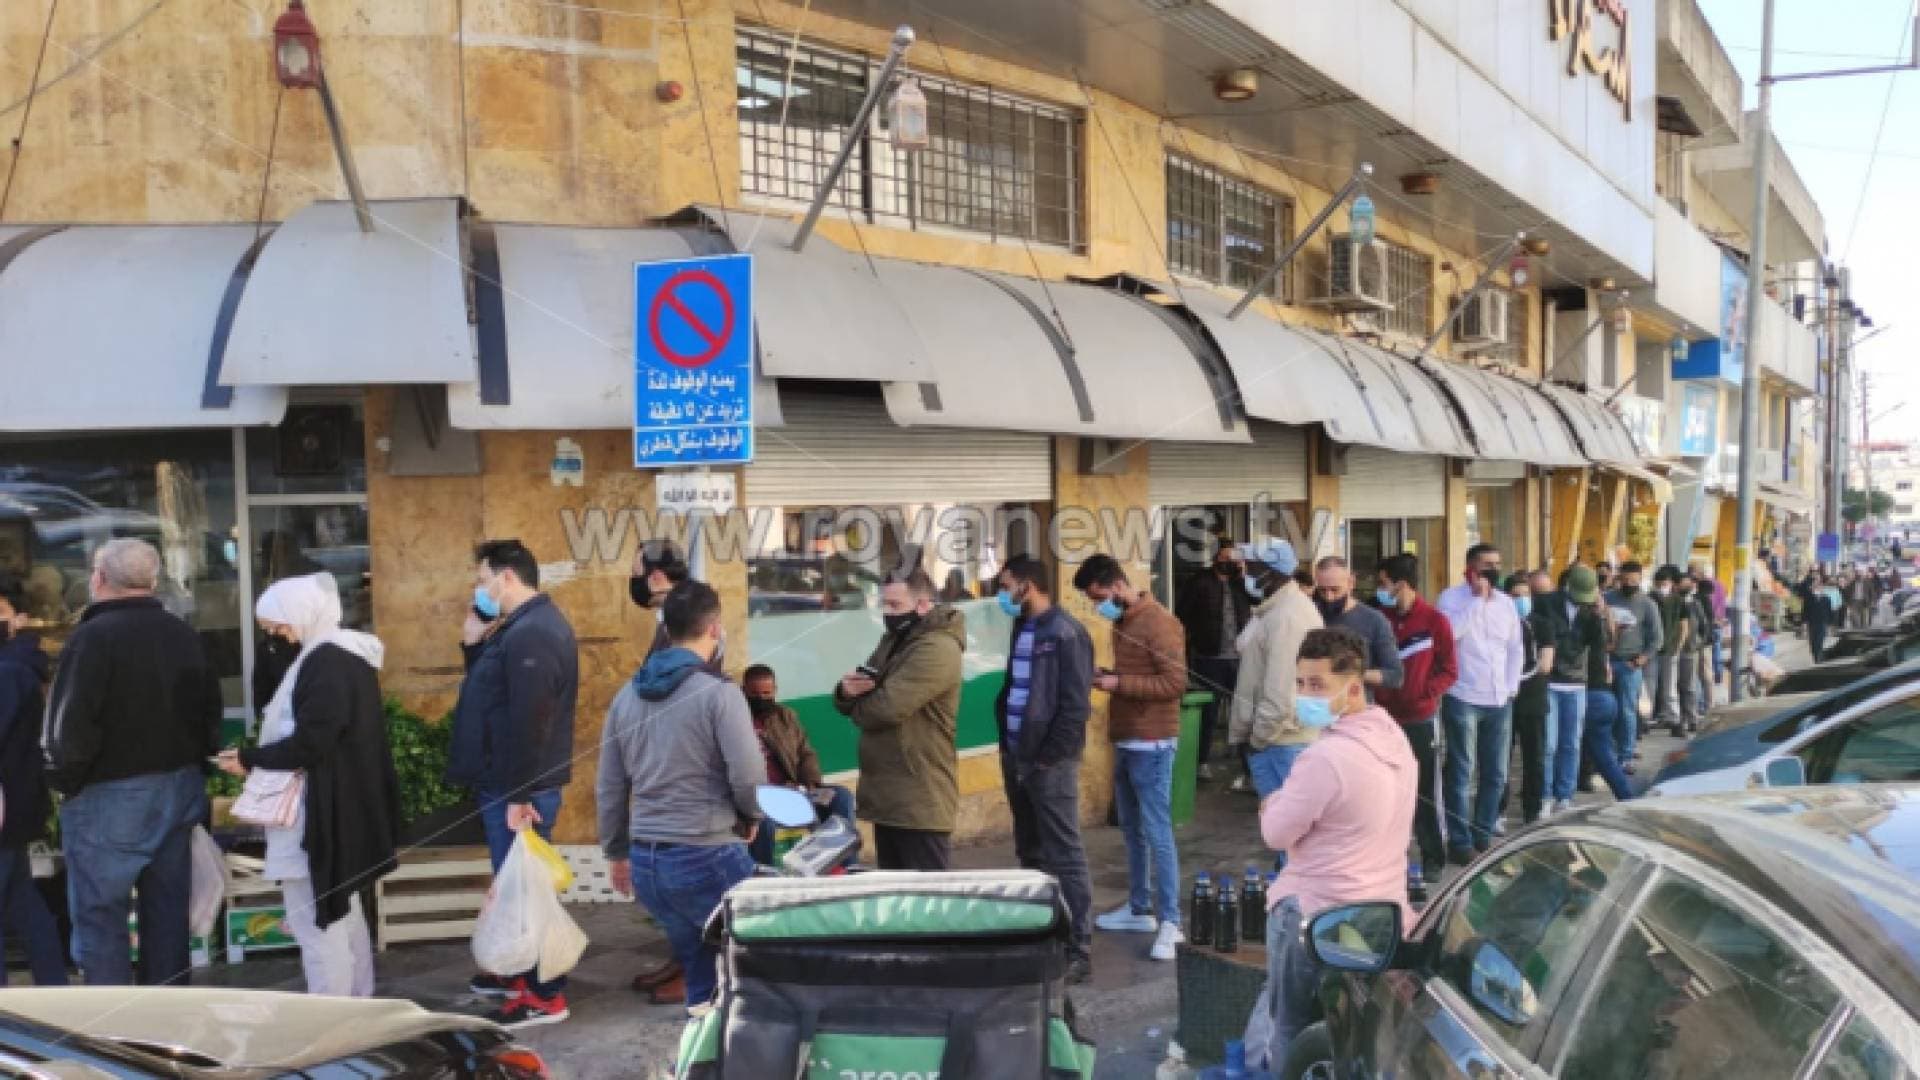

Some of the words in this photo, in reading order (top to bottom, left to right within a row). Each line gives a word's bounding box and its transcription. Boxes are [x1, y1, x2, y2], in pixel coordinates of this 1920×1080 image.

[670, 369, 708, 395] الوقوف
[711, 370, 735, 397] يمنع
[648, 399, 681, 424] دقيقة
[697, 404, 713, 424] عن
[718, 397, 743, 424] تزيد
[673, 430, 702, 454] بشكل
[705, 429, 743, 452] الوقوف
